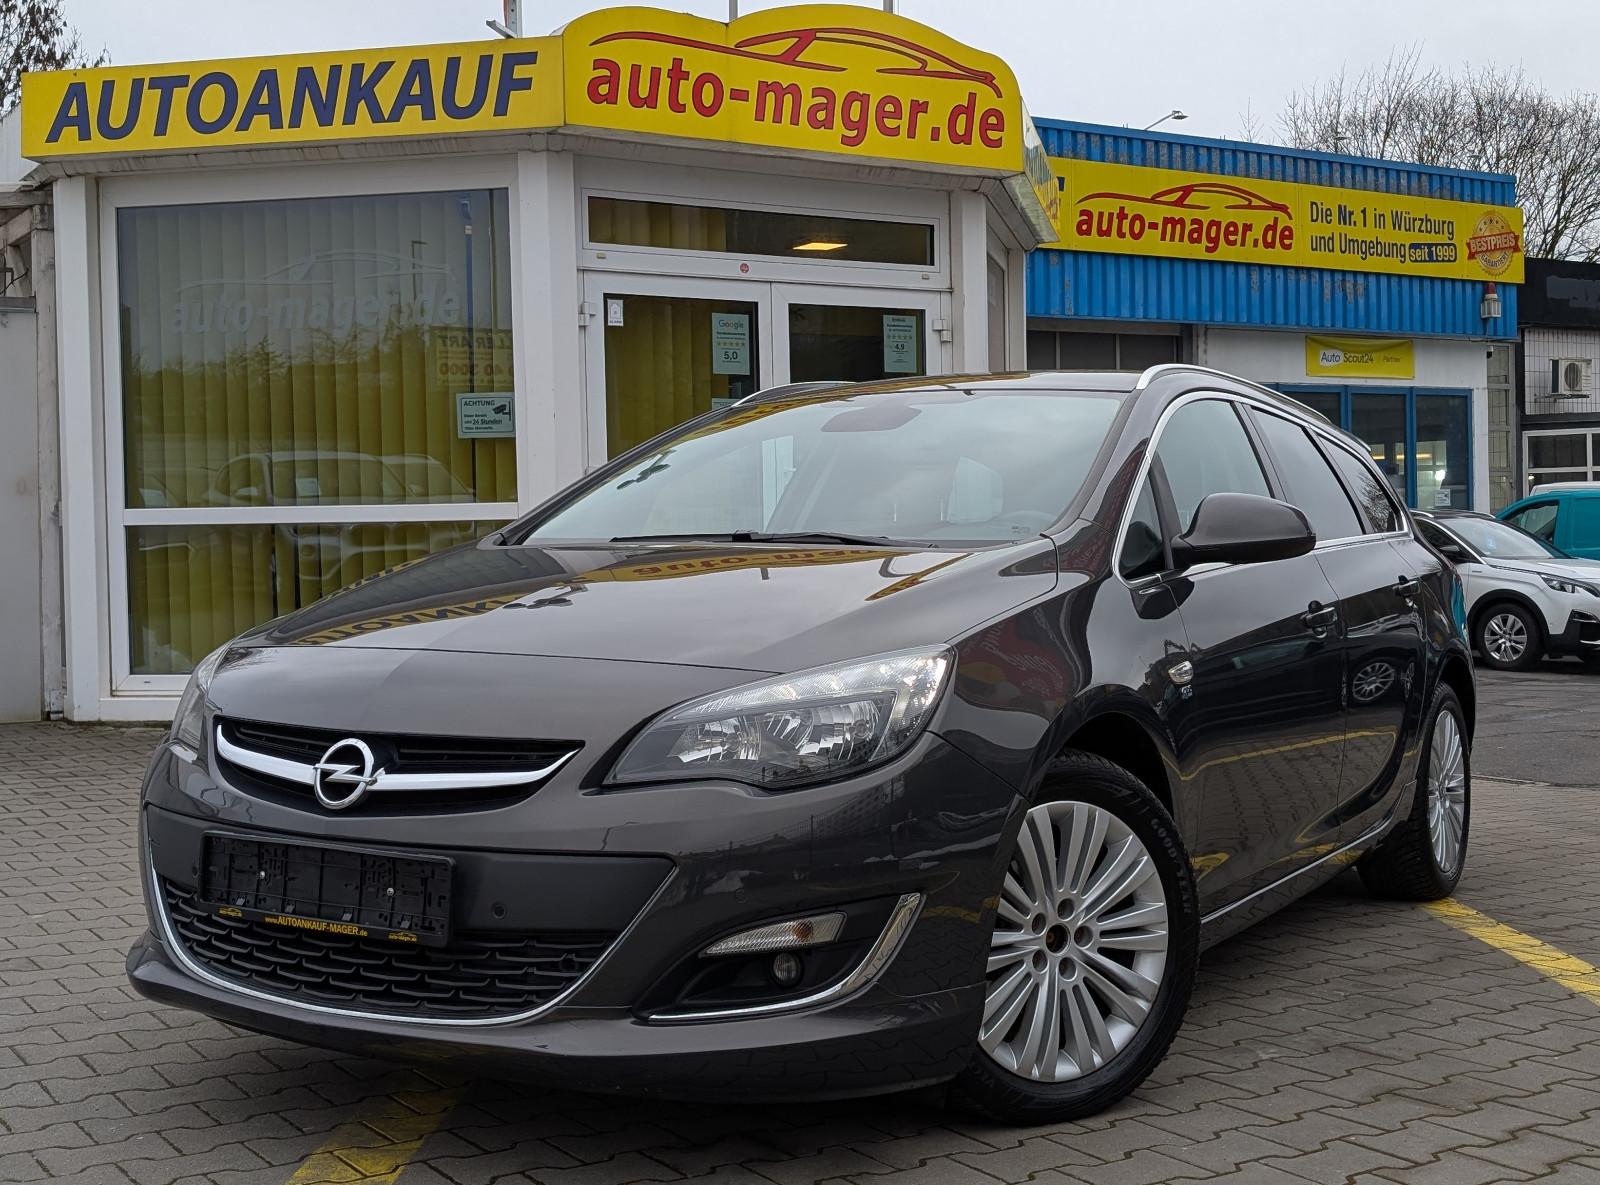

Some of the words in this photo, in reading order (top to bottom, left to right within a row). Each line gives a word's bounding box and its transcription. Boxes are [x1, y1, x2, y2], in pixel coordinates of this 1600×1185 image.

[45, 51, 539, 144] AUTOANKAUF
[586, 57, 1006, 149] auto-mager.de
[1075, 206, 1294, 254] auto-mager.de
[1310, 201, 1333, 225] Die
[1337, 204, 1357, 227] Nr.
[1360, 206, 1368, 228] 1
[1373, 207, 1386, 230] in
[1390, 209, 1455, 241] Würzburg
[1310, 232, 1335, 254] und
[1339, 233, 1406, 264] Umgebung
[1409, 245, 1429, 260] seit
[1432, 244, 1456, 262] 1999
[1470, 233, 1515, 253] BESTPREIS
[718, 319, 744, 330] Google
[723, 351, 738, 361] 5,0
[1321, 351, 1341, 363] Auto
[1343, 352, 1374, 364] Scout24
[264, 915, 368, 937] www.AUTOANKAUF-MAGER.de
